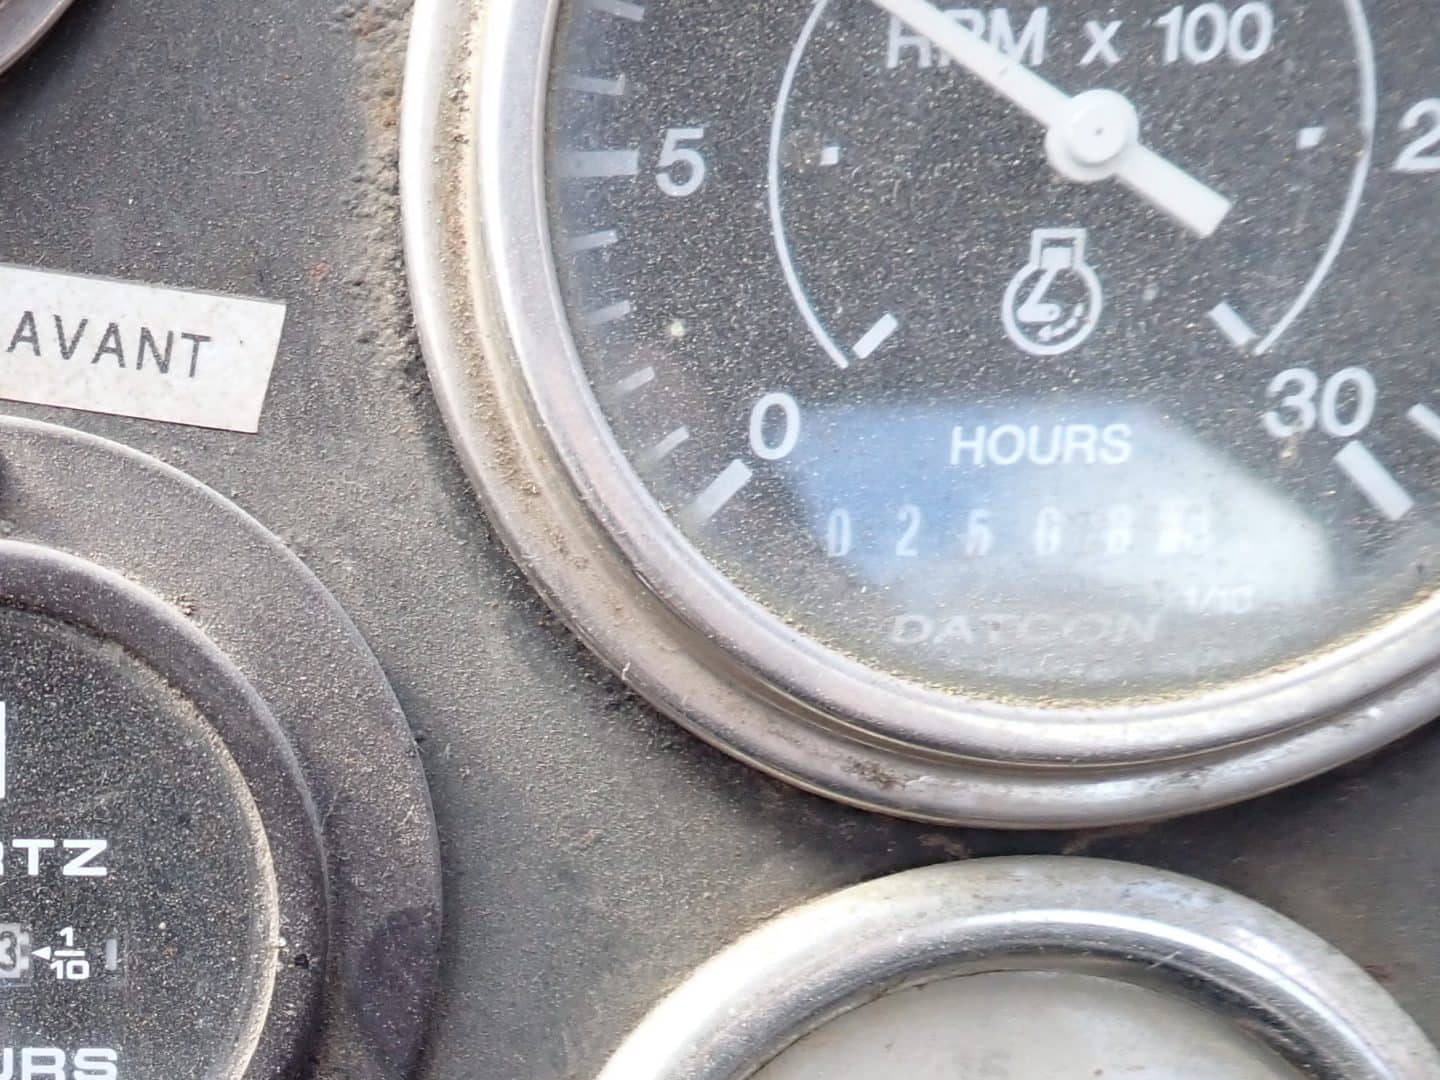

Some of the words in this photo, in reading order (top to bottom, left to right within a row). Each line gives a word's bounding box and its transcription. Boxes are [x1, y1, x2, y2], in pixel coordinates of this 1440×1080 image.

[1157, 1, 1274, 65] 100
[655, 127, 706, 197] 5
[748, 392, 800, 460] 0
[1262, 366, 1378, 440] 30
[949, 424, 1133, 466] HOURS
[890, 612, 1160, 646] DATCON
